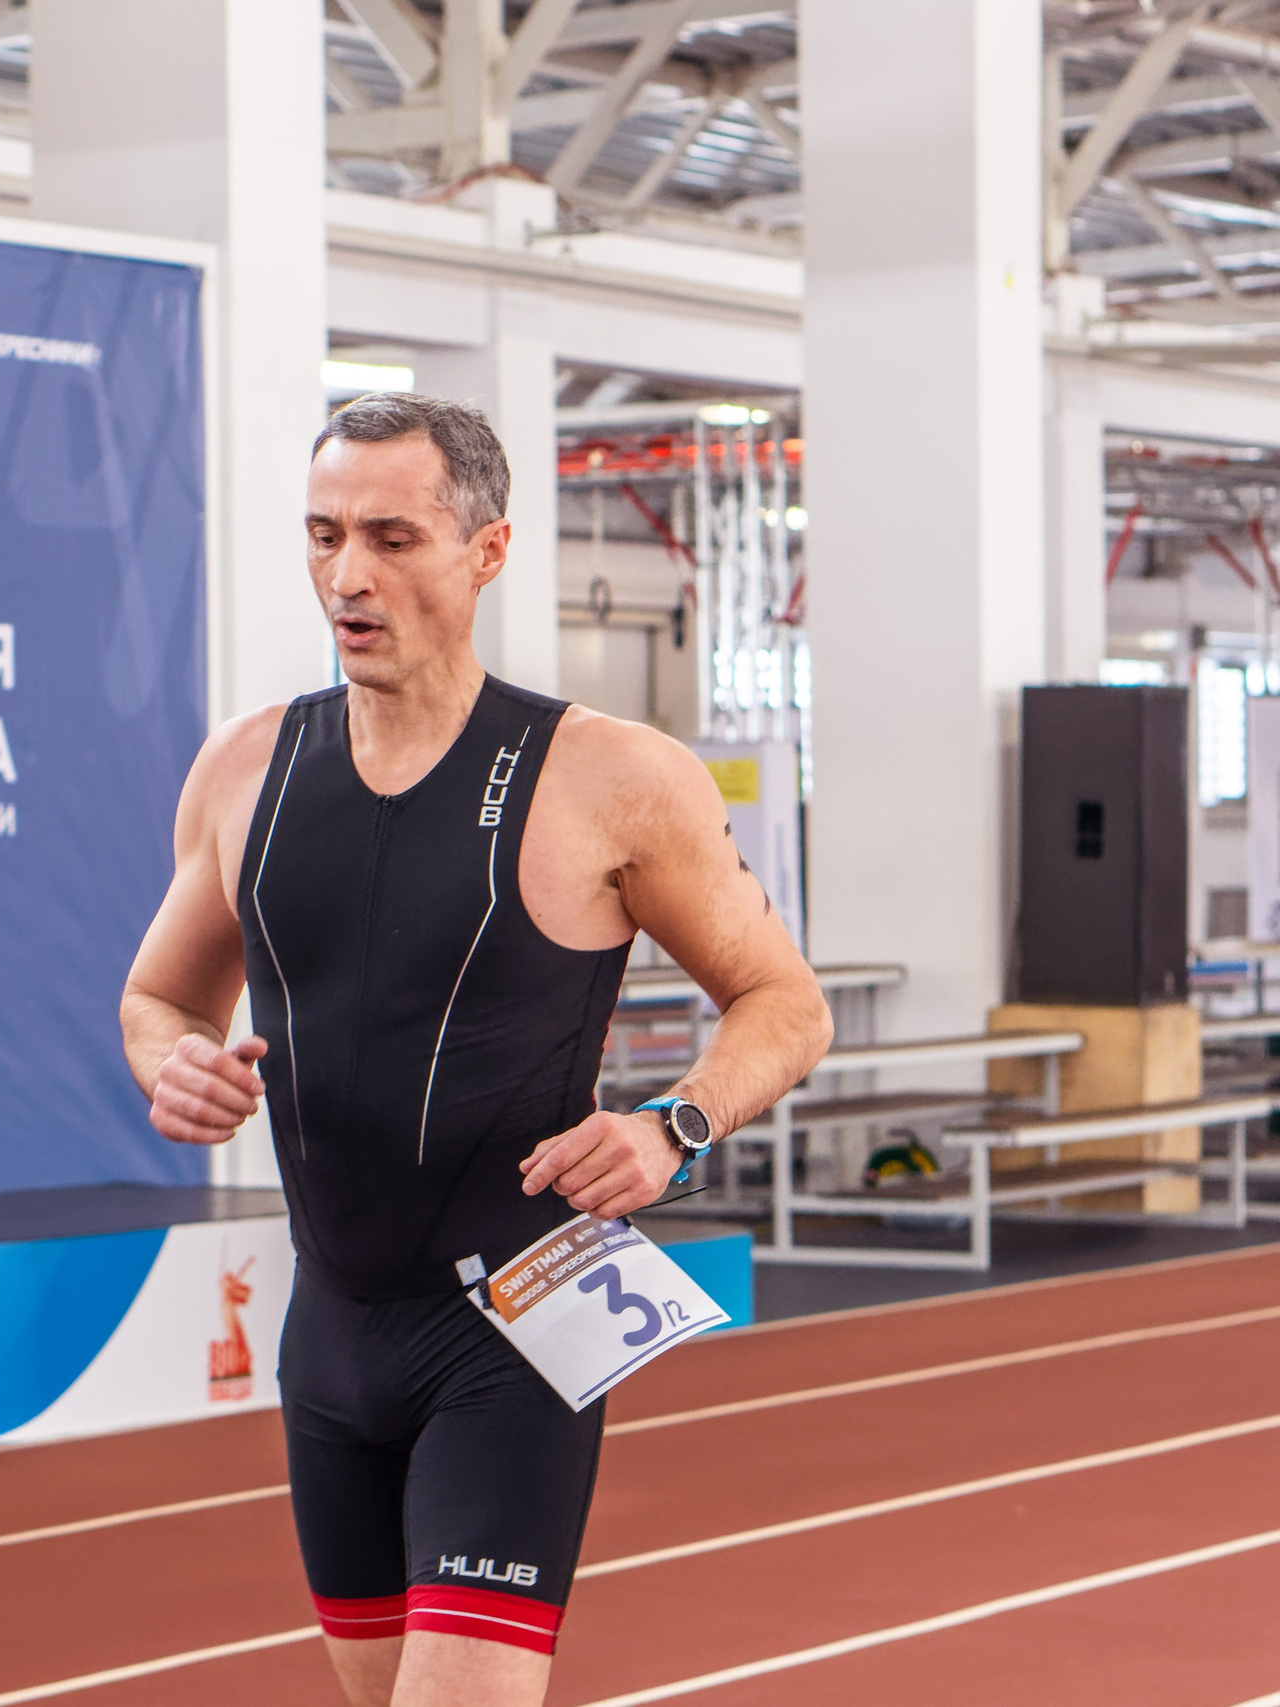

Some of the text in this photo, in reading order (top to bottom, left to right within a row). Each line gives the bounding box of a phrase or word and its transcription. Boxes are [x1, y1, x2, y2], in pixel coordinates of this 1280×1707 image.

[478, 746, 521, 826] HUUB
[499, 1239, 574, 1298] SWIFTMAN
[511, 1279, 549, 1310] INDOOR
[548, 1241, 606, 1282] SUPERSPRINT
[438, 1554, 539, 1586] HUUB
